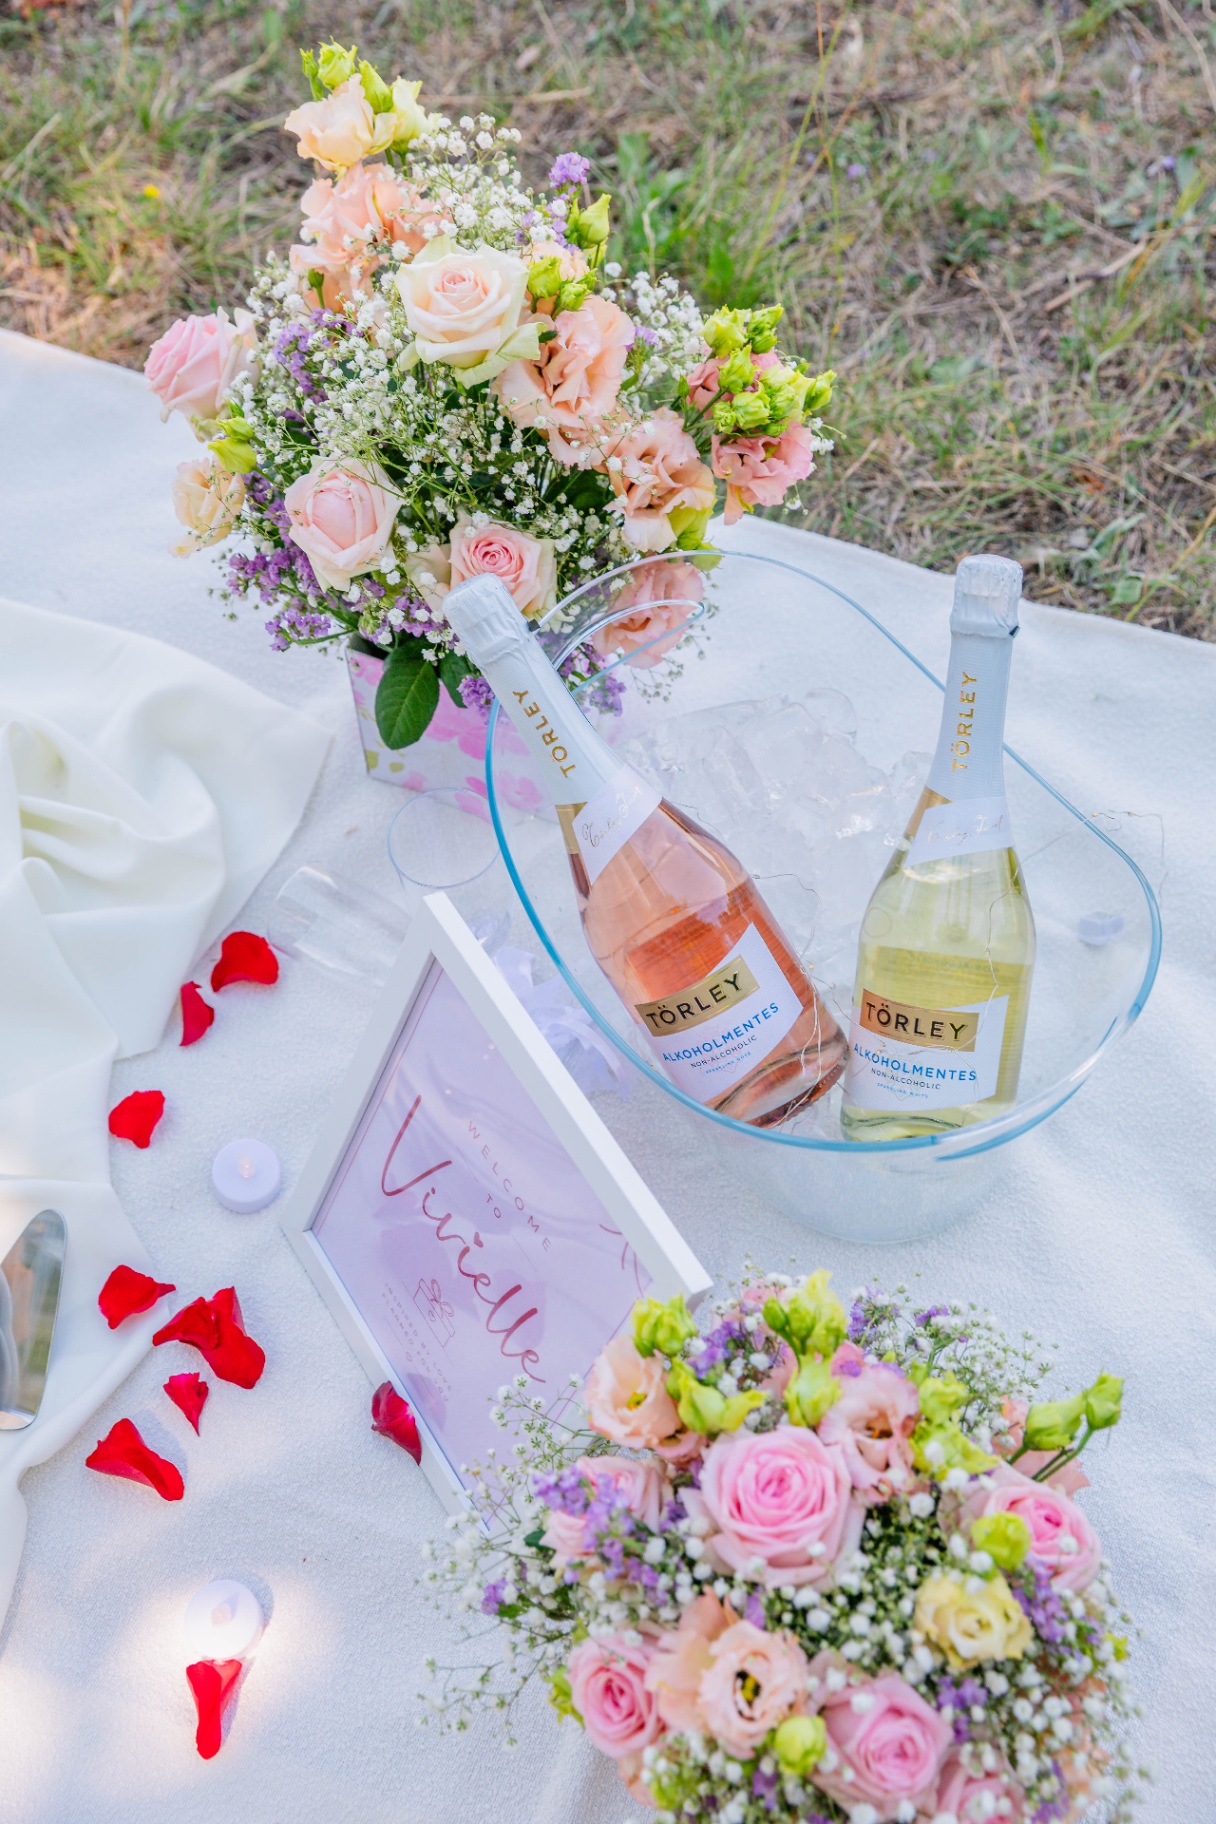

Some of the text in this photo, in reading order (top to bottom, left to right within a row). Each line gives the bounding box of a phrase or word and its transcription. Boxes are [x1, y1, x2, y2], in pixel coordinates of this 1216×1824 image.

[512, 689, 577, 779] TÖRLEY
[951, 671, 977, 773] TÖRLEY
[645, 970, 740, 1029] TÖRLEY
[662, 1002, 780, 1063] ALKOHOLMENTES
[865, 1001, 968, 1041] TÖRLEY
[690, 1034, 758, 1069] NON-ALCOHOLIC
[853, 1042, 977, 1082] ALKOHOLMENTES
[870, 1067, 942, 1091] NON-ALCOHOLIC
[467, 1121, 551, 1252] WELCOME
[486, 1193, 502, 1219] TO
[433, 1361, 452, 1392] LOVE
